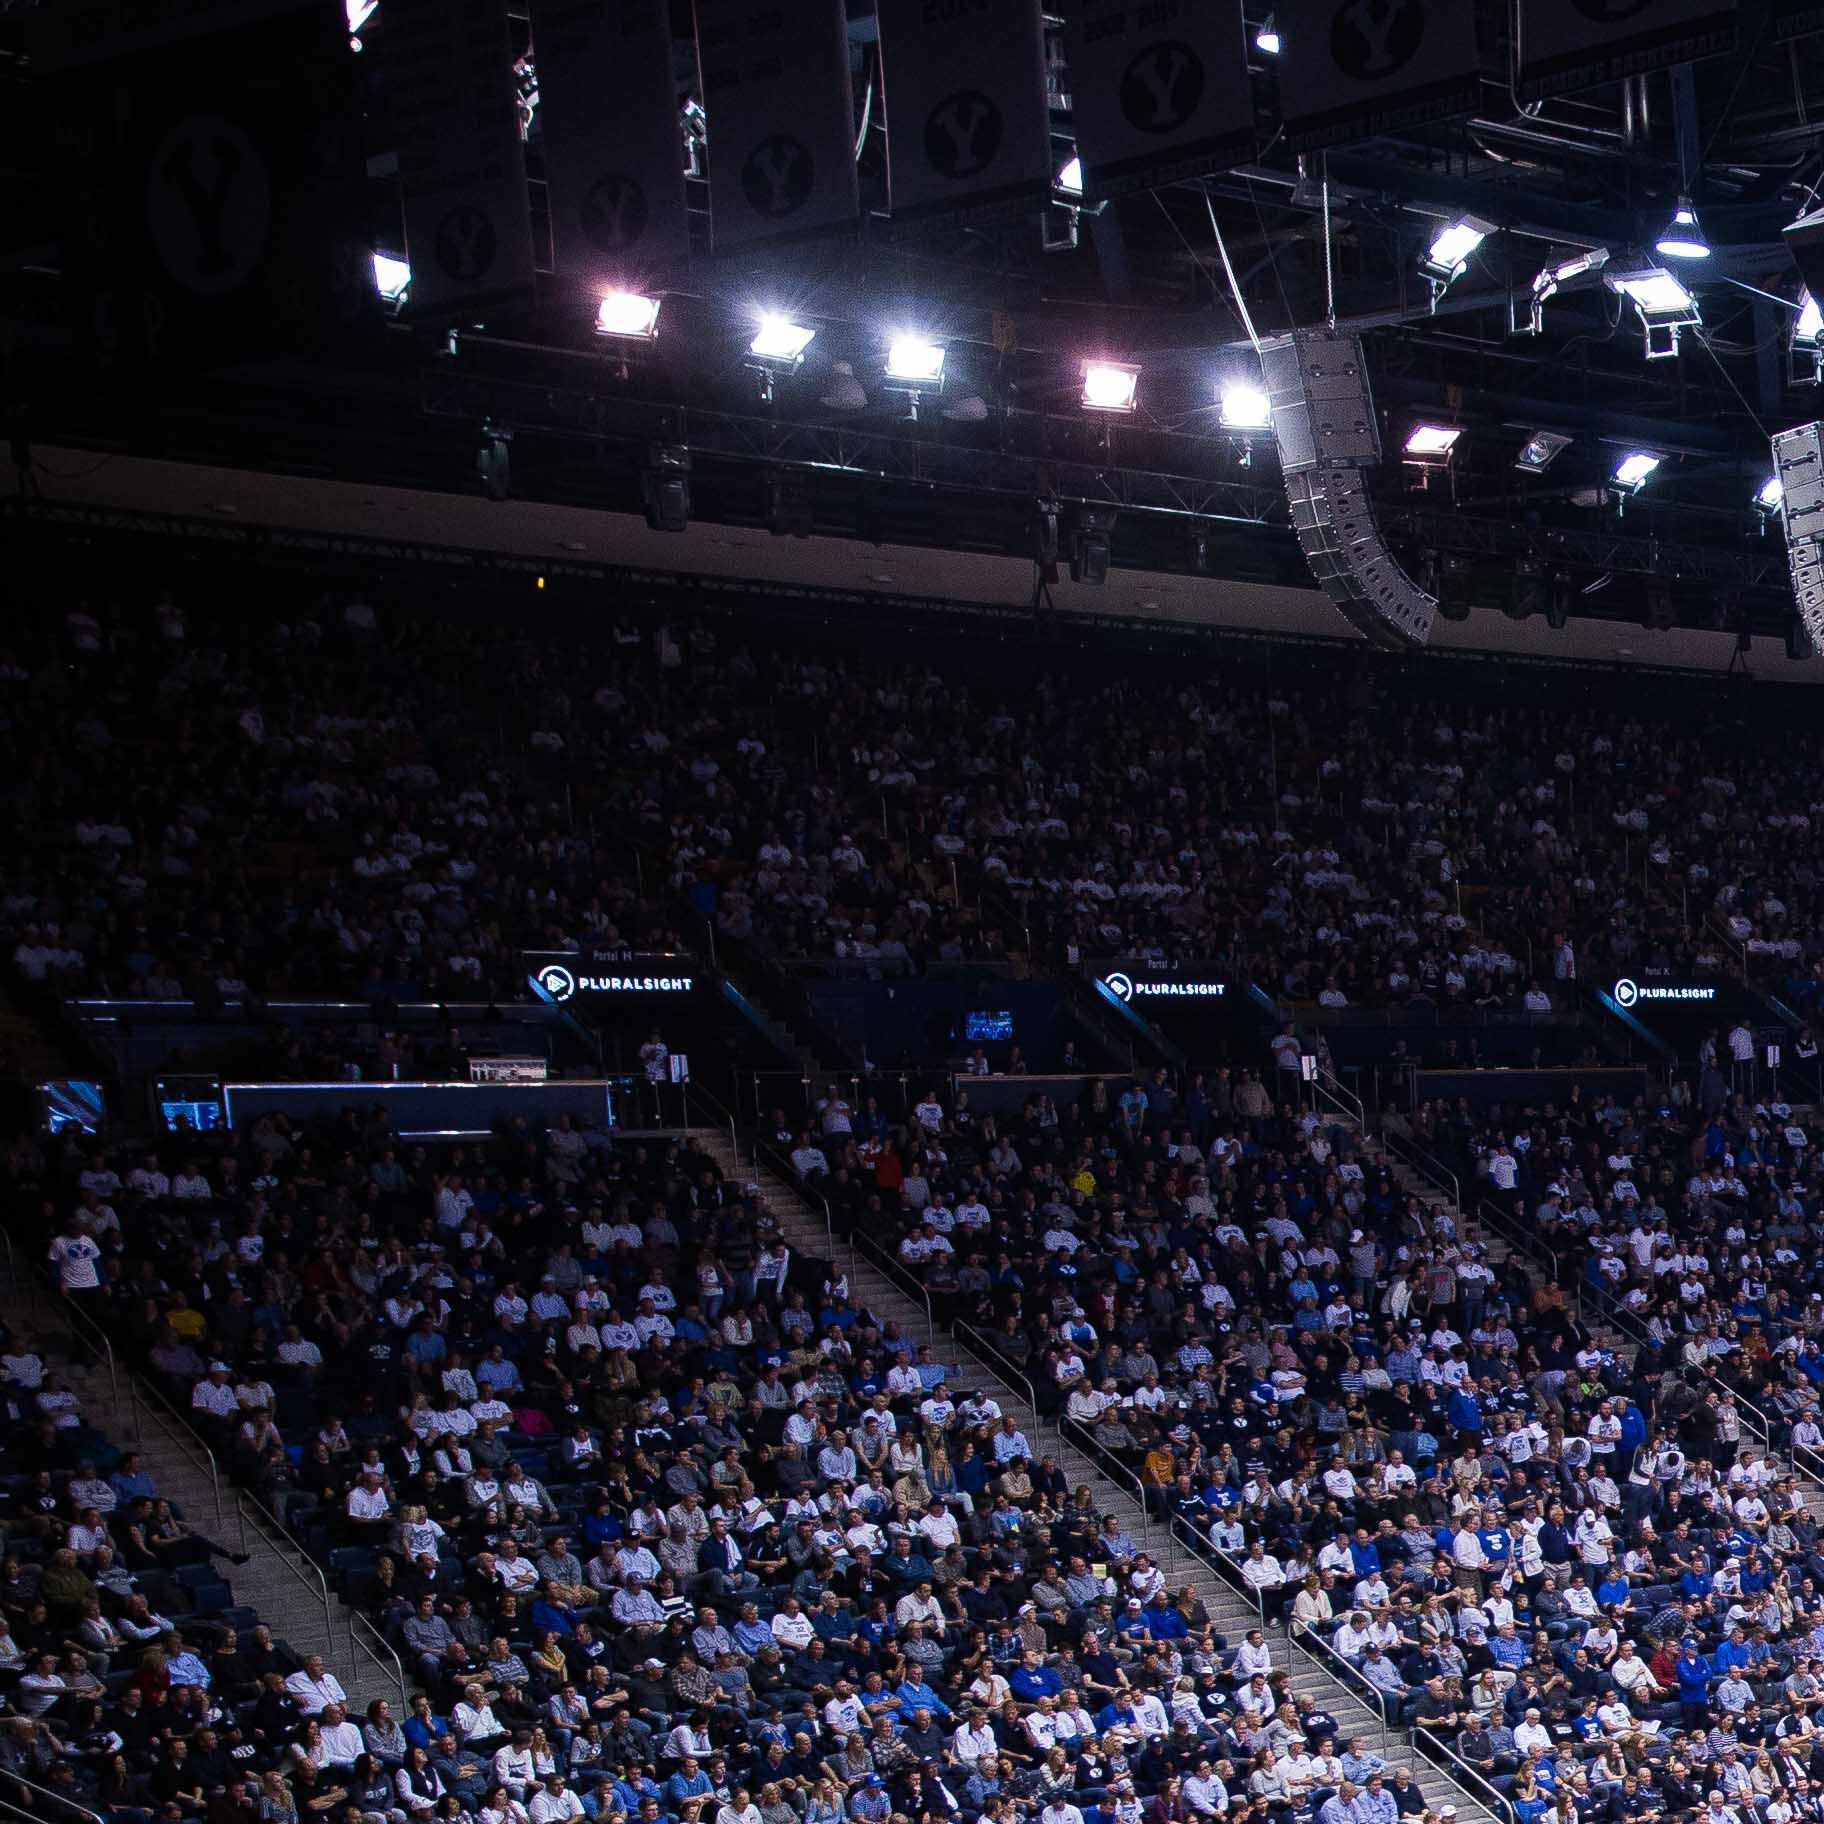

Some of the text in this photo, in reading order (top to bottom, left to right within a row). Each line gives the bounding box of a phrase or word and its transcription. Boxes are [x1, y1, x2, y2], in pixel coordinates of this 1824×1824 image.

[578, 976, 693, 991] PLURALSIGHT
[1135, 983, 1225, 995] PLURALSIGHT
[1639, 987, 1715, 999] PLURALSIGHT
